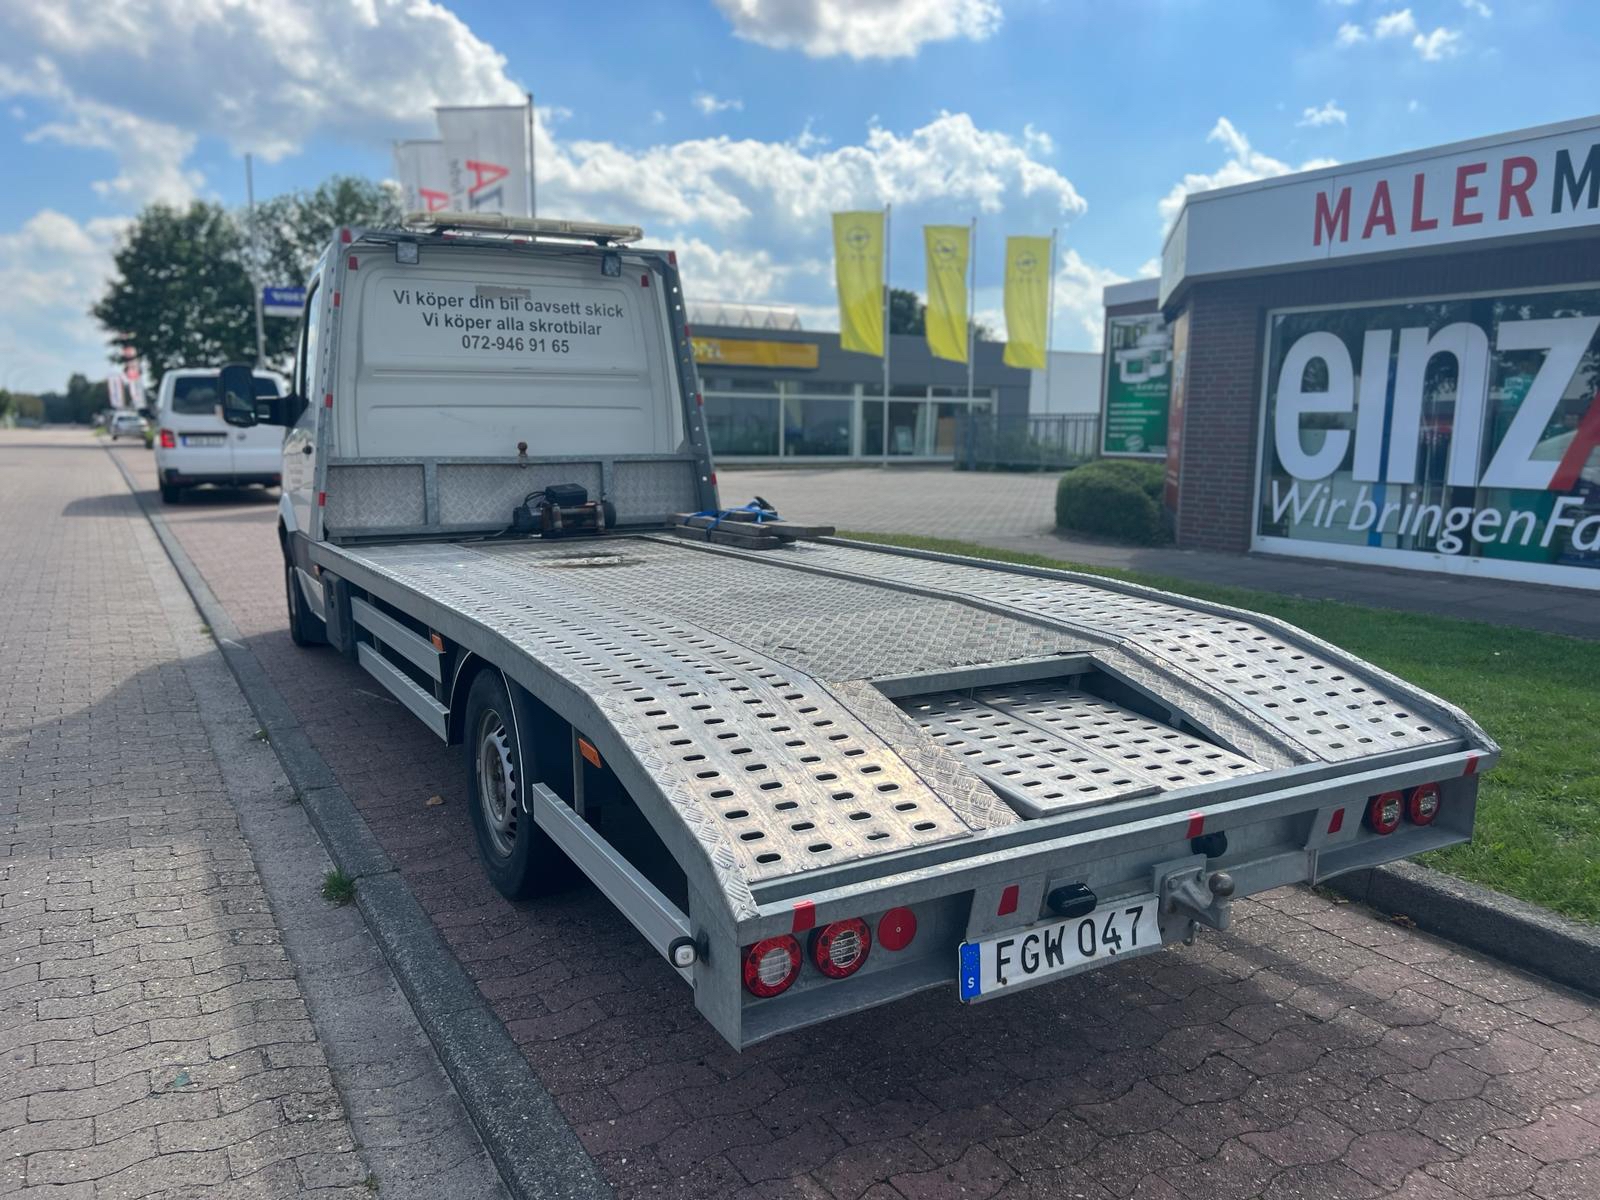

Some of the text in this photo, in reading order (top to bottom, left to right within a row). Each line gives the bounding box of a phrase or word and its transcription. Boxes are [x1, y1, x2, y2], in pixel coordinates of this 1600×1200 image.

[393, 289, 624, 319] Vi köper din bil oavsett skick
[422, 312, 602, 336] Vi köper alla skrotbilar
[462, 335, 570, 353] 072-946 91 65
[1271, 480, 1346, 528] Wir
[1348, 485, 1536, 554] bringen
[996, 906, 1144, 984] FGW 047
[967, 977, 975, 989] S
